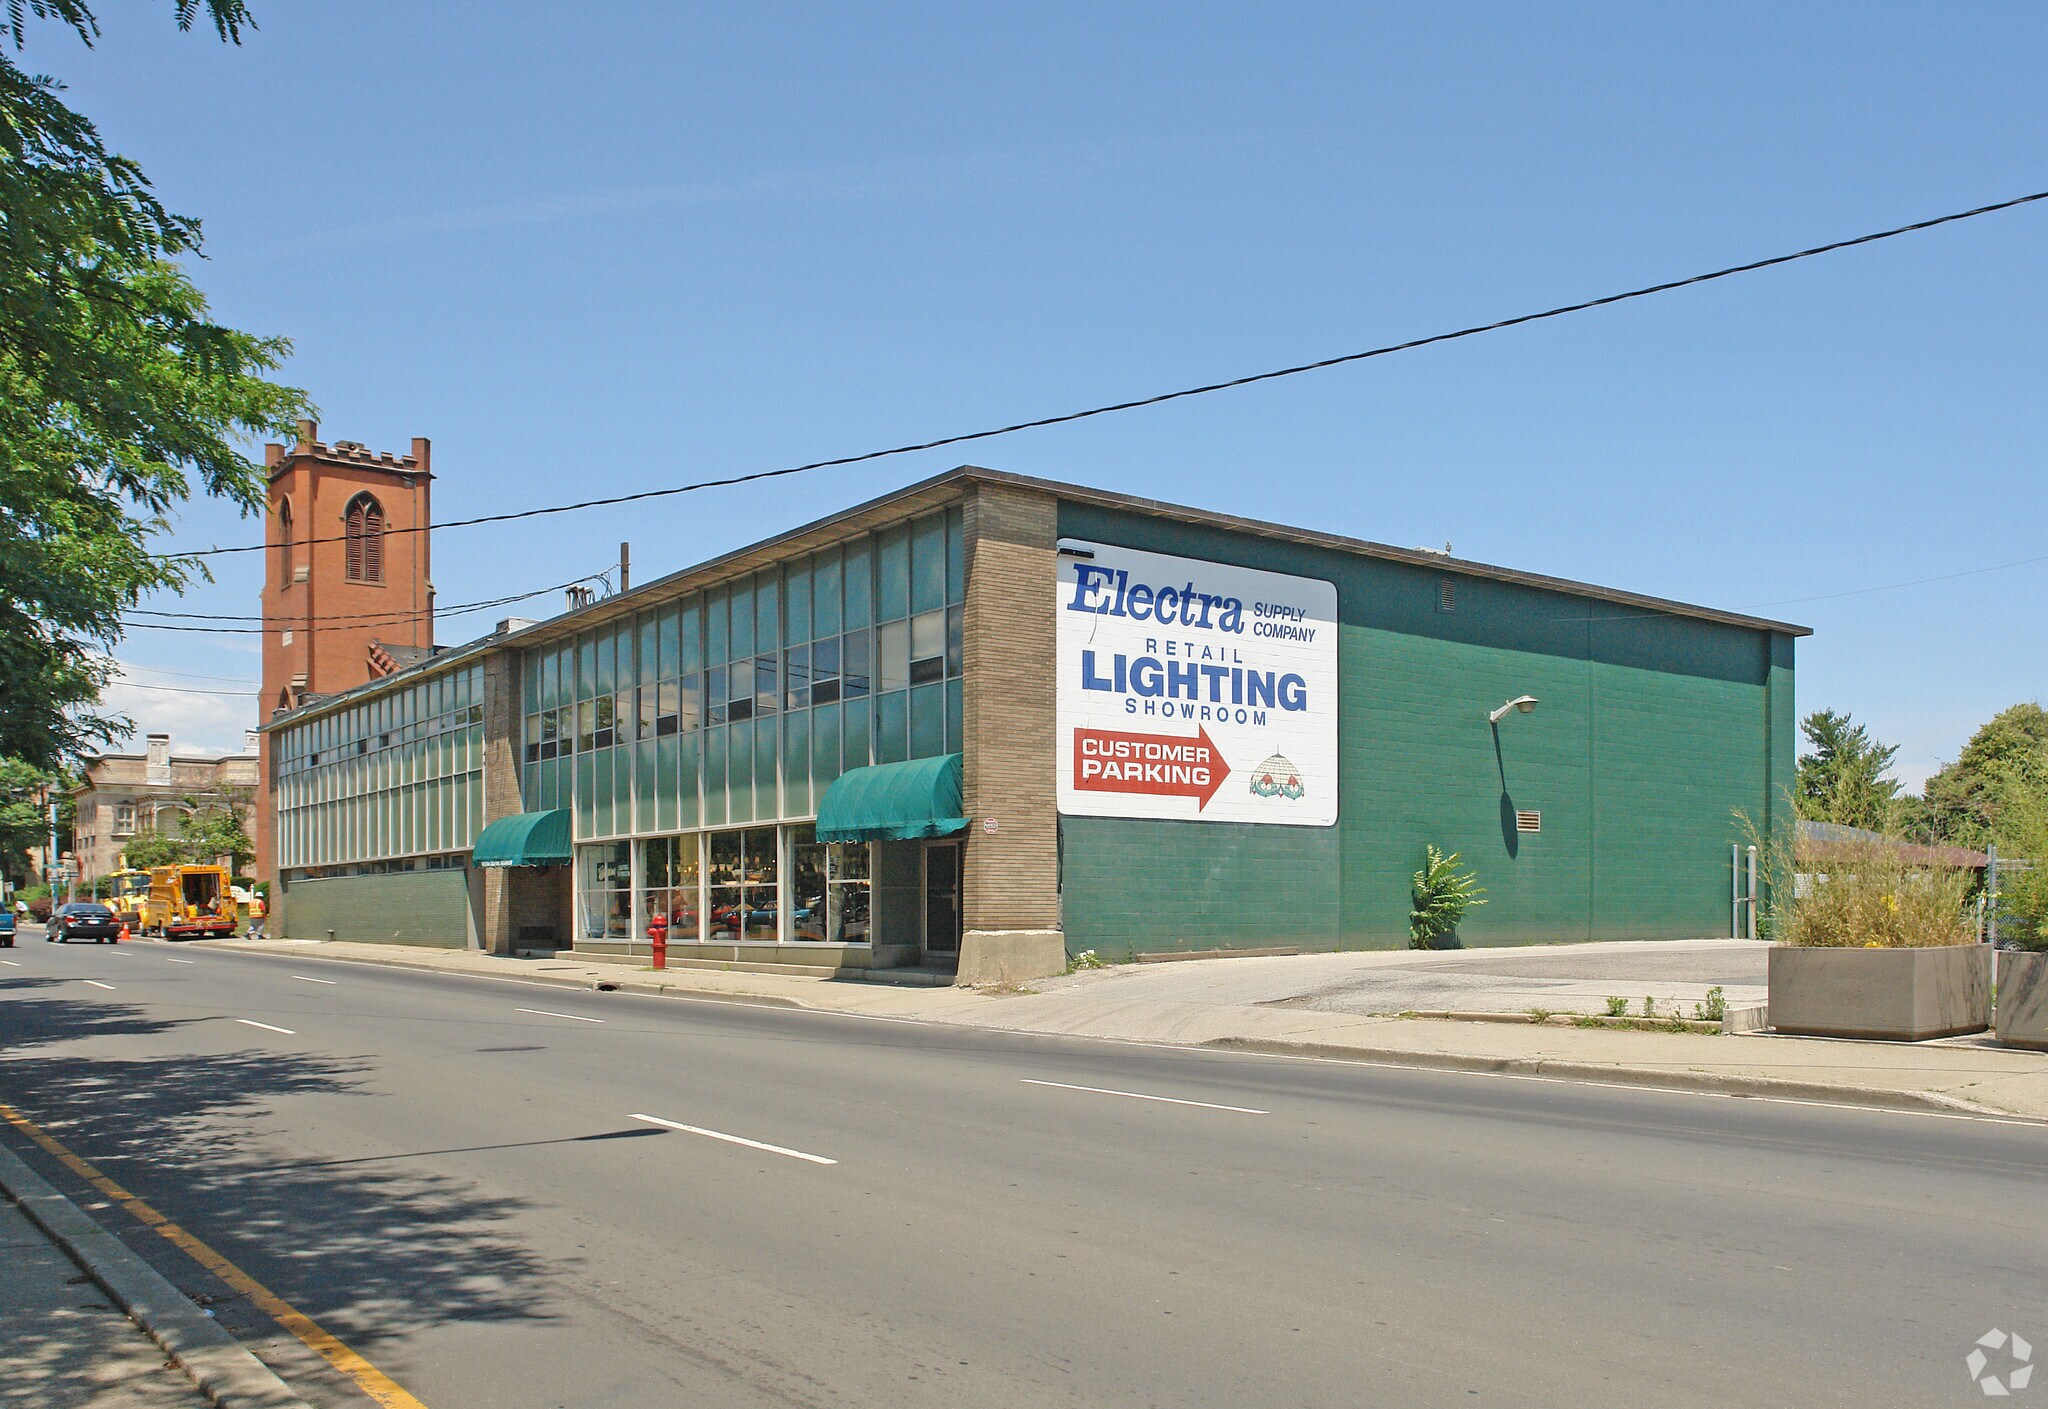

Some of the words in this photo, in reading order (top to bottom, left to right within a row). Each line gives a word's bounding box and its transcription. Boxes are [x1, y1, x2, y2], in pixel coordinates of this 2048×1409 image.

[1067, 563, 1245, 634] Electra
[1254, 602, 1306, 622] SUPPLY
[1253, 621, 1316, 643] COMPANY
[1146, 638, 1243, 664] RETAIL
[1082, 649, 1307, 712] LIGHTING
[1125, 698, 1266, 726] SHOWROOM
[1082, 738, 1210, 763] CUSTOMER
[1082, 758, 1211, 786] PARKING
